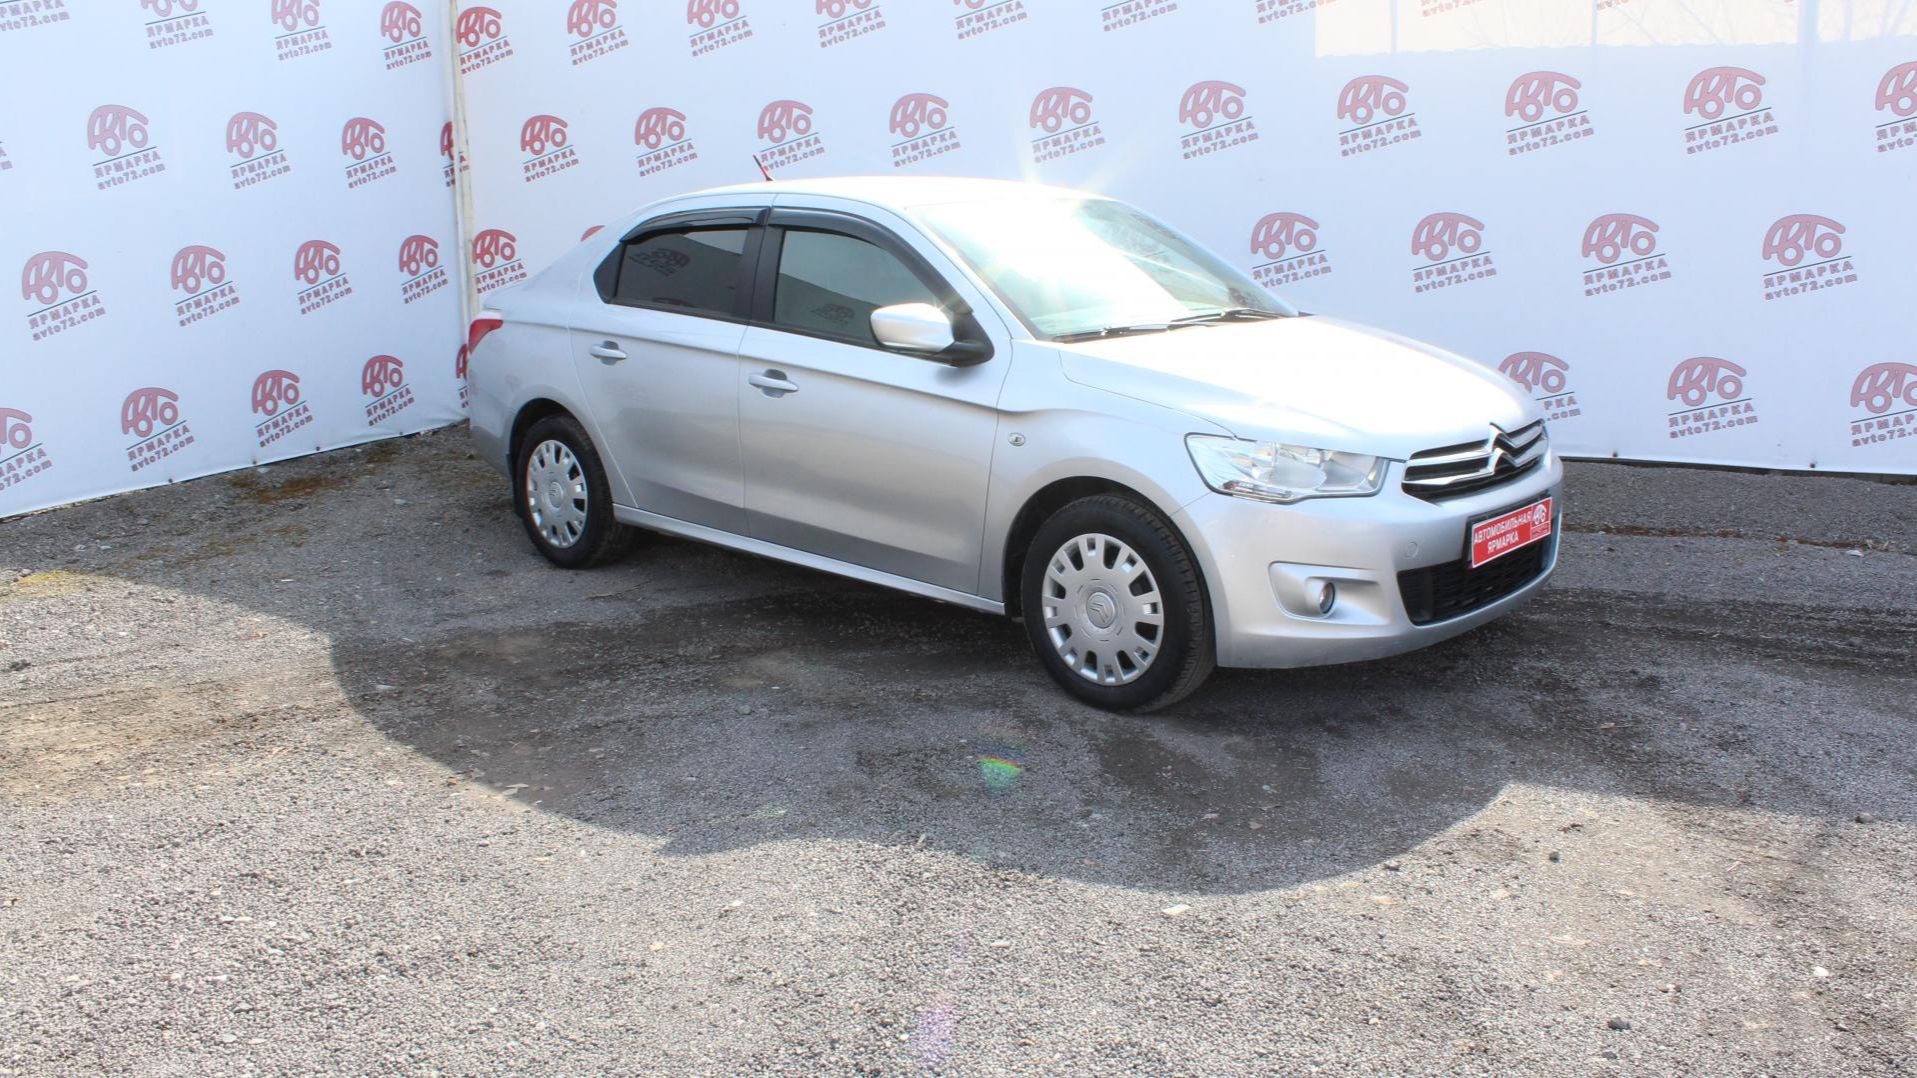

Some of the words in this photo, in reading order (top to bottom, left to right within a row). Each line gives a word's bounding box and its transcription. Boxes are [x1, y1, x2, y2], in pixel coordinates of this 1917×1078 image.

[0, 0, 65, 18] РМАРКА
[0, 11, 70, 32] vto72.com
[1103, 3, 1177, 32] avto72.com
[146, 15, 209, 38] ЯРМАРКА
[690, 20, 749, 48] ЯРМАРКА
[818, 10, 882, 38] ЯРМАРКА
[820, 21, 886, 48] avto72.com
[958, 12, 1027, 40] avto72.com
[149, 28, 214, 49] avto72.com
[276, 30, 328, 50] ЯРМАРКА
[278, 42, 332, 61] avto72.com
[384, 41, 428, 60] ЯРМАРКА
[570, 29, 625, 56] ЯРМАРКА
[692, 30, 752, 56] avto72.com
[386, 51, 432, 70] avto72.com
[460, 39, 510, 65] ЯРМАРКА
[461, 49, 513, 74] avto72.com
[572, 39, 628, 65] avto72.com
[1033, 126, 1101, 152] ЯРМАРКА
[1181, 120, 1255, 150] ЯРМАРКА
[1340, 117, 1417, 146] ЯРМАРКА
[1507, 115, 1590, 144] ЯРМАРКА
[1685, 112, 1775, 143] ЯРМАРКА
[1686, 125, 1778, 154] avto72.com
[760, 136, 822, 163] ЯРМАРКА
[892, 130, 957, 158] ЯРМАРКА
[894, 141, 961, 168] avto72.com
[1035, 137, 1105, 162] avto72.com
[1183, 132, 1259, 160] avto72.com
[1341, 130, 1422, 157] avto72.com
[1508, 127, 1594, 156] avto72.com
[94, 150, 161, 178] ЯРМАРКА
[231, 153, 287, 179] ЯРМАРКА
[346, 155, 394, 179] ЯРМАРКА
[524, 149, 576, 174] ЯРМАРКА
[638, 142, 694, 168] ЯРМАРКА
[639, 152, 698, 177] avto72.com
[97, 163, 166, 190] avto72.com
[234, 165, 291, 190] avto72.com
[348, 166, 397, 189] avto72.com
[525, 158, 579, 182] avto72.com
[475, 262, 524, 284] ЯРМАРКА
[1253, 254, 1328, 280] ЯРМАРКА
[1262, 266, 1332, 288] vto72.com
[1413, 255, 1493, 282] ЯРМАРКА
[1583, 258, 1668, 286] ЯРМАРКА
[1764, 260, 1854, 288] ЯРМАРКА
[299, 277, 348, 304] ЯРМАРКА
[402, 269, 445, 295] ЯРМАРКА
[404, 279, 448, 304] avto72.com
[477, 272, 527, 294] avto72.com
[1415, 268, 1497, 293] avto72.com
[1584, 271, 1672, 296] avto72.com
[1764, 274, 1858, 300] avto72.com
[29, 295, 101, 330] ЯРМАРКА
[176, 285, 236, 316] ЯРМАРКА
[179, 296, 240, 327] avto72.com
[301, 287, 352, 314] avto72.com
[32, 307, 106, 341] avto72.com
[366, 388, 411, 417] ЯРМАРКА
[369, 397, 414, 426] avto72.com
[1668, 402, 1754, 428] ЯРМАРКА
[257, 405, 309, 438] ЯРМАРКА
[260, 415, 312, 448] avto72.com
[1669, 415, 1758, 439] avto72.com
[1851, 414, 1914, 436] ЯРМАР
[128, 425, 190, 461] ЯРМАРКА
[131, 436, 194, 472] avto72.com
[1474, 511, 1533, 544] АВТОМОБИЛЬНАЯ
[1487, 531, 1519, 554] ЯРМАРКА
